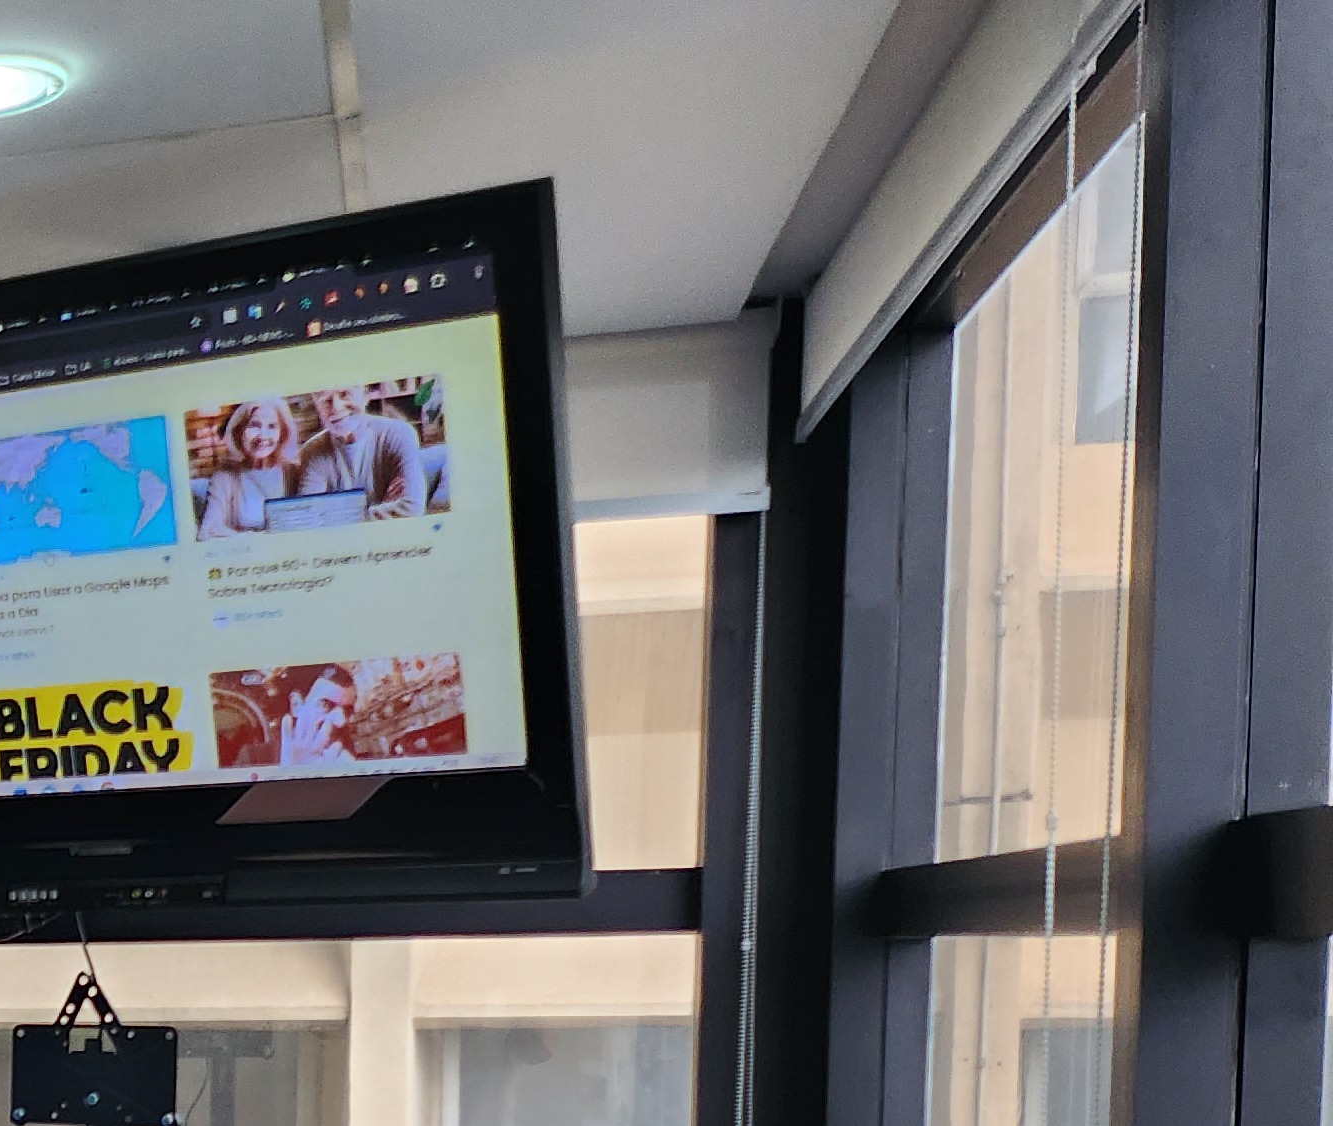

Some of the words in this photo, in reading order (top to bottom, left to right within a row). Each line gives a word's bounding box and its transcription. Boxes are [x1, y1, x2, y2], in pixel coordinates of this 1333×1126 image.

[365, 546, 433, 565] Aprender
[12, 587, 41, 604] para
[44, 585, 71, 598] Usar
[85, 578, 131, 594] Google
[133, 575, 170, 590] Maps
[208, 584, 247, 599] Sobre
[18, 606, 38, 618] Dia
